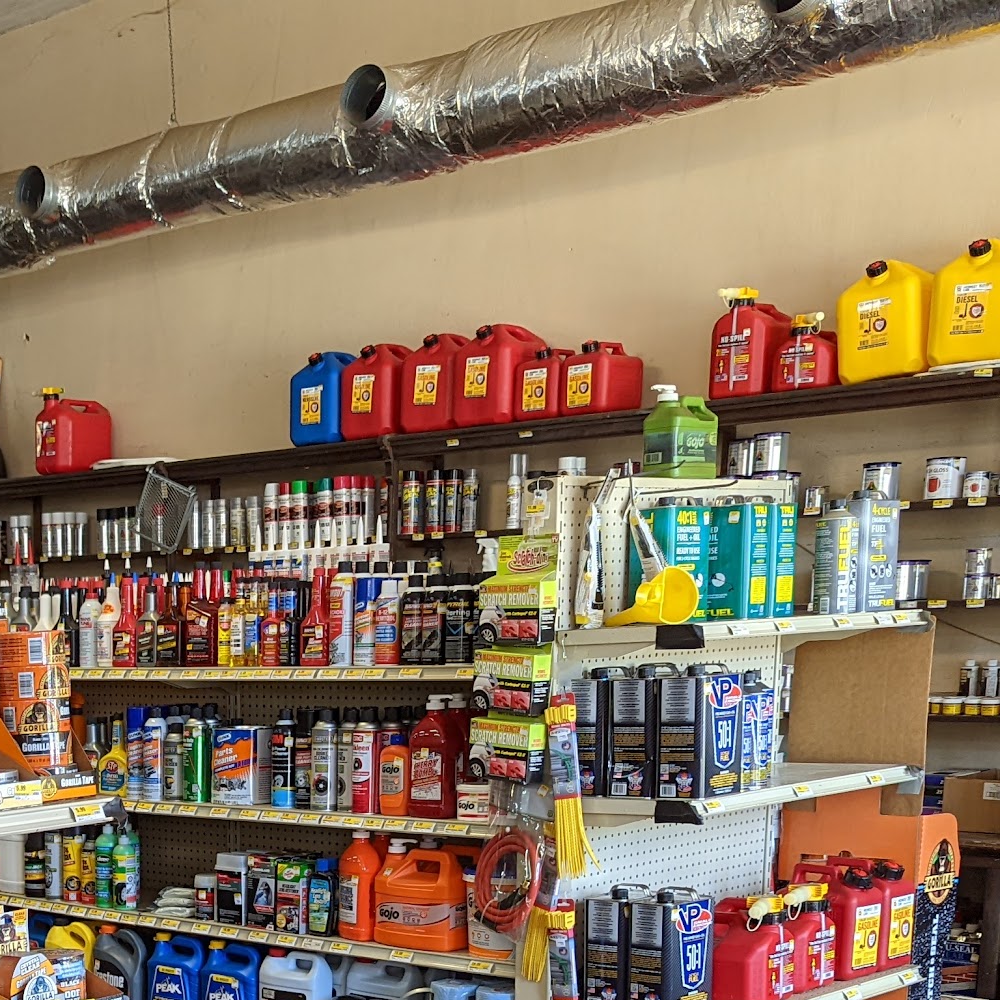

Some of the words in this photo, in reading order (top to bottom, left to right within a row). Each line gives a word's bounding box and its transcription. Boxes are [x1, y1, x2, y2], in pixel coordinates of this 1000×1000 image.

[956, 296, 978, 304] DIESEL
[860, 311, 880, 320] DIESEL
[686, 437, 705, 448] GOJO
[872, 503, 890, 516] 4-CYCLE
[677, 510, 693, 525] 40:1
[871, 525, 886, 533] FUEL
[837, 526, 849, 610] TRUFUEL
[480, 593, 506, 606] SCRATCH
[509, 593, 538, 606] REMOVER
[868, 598, 894, 608] TRUFUEL
[475, 660, 501, 675] SCRATCH
[503, 663, 532, 678] REMOVER
[711, 677, 733, 707] VP
[470, 729, 496, 744] SCRATCH
[499, 732, 528, 747] REMOVER
[718, 720, 732, 748] 50:1
[22, 743, 49, 752] GORILLA
[215, 746, 233, 757] Parts
[213, 755, 238, 765] Cleaner
[61, 778, 81, 787] GORILLA
[82, 775, 94, 785] TAPE
[927, 876, 952, 890] GORILLA
[380, 906, 399, 920] GOJO
[679, 903, 701, 932] VP
[894, 908, 911, 920] GASOLINE
[858, 918, 878, 930] GASOLINE
[686, 942, 701, 972] 50:1
[61, 980, 80, 988] BLACK
[156, 982, 181, 994] PEAK
